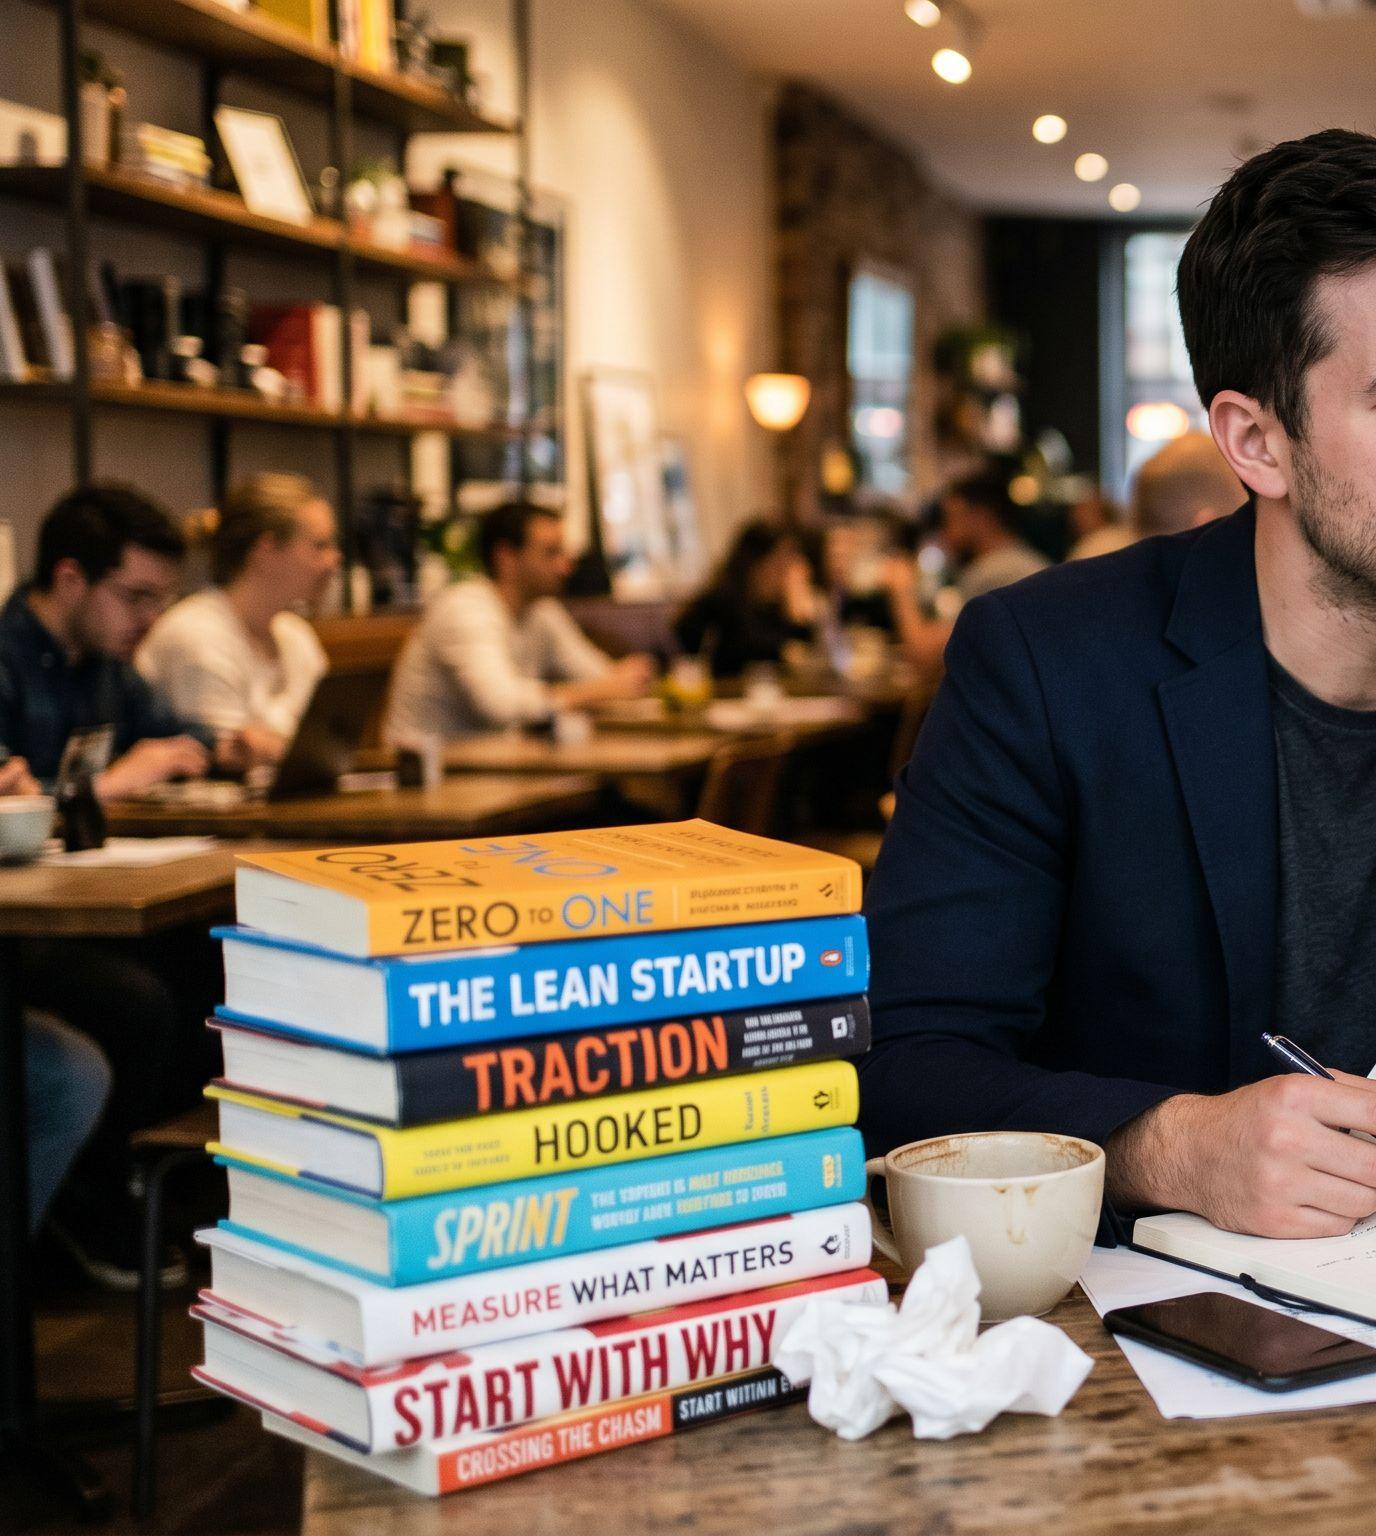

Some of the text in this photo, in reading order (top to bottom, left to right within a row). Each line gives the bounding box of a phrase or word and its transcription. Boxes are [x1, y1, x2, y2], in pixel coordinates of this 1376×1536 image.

[402, 900, 519, 945] ZERO
[529, 905, 555, 926] TO
[562, 890, 655, 931] ONE
[409, 980, 497, 1027] THE
[510, 965, 620, 1015] LEAN
[630, 943, 806, 1001] STARTUP
[463, 1016, 729, 1112] TRACTION
[534, 1103, 702, 1164] HOOKED
[427, 1187, 579, 1270] SPRINT
[413, 1286, 562, 1336] MEASURE
[570, 1268, 655, 1304] WHAT
[665, 1240, 794, 1287] MATTERS
[394, 1311, 776, 1447] START WITH WHY
[680, 1391, 722, 1420] START
[456, 1411, 663, 1481] CROSSING THE CHASM
